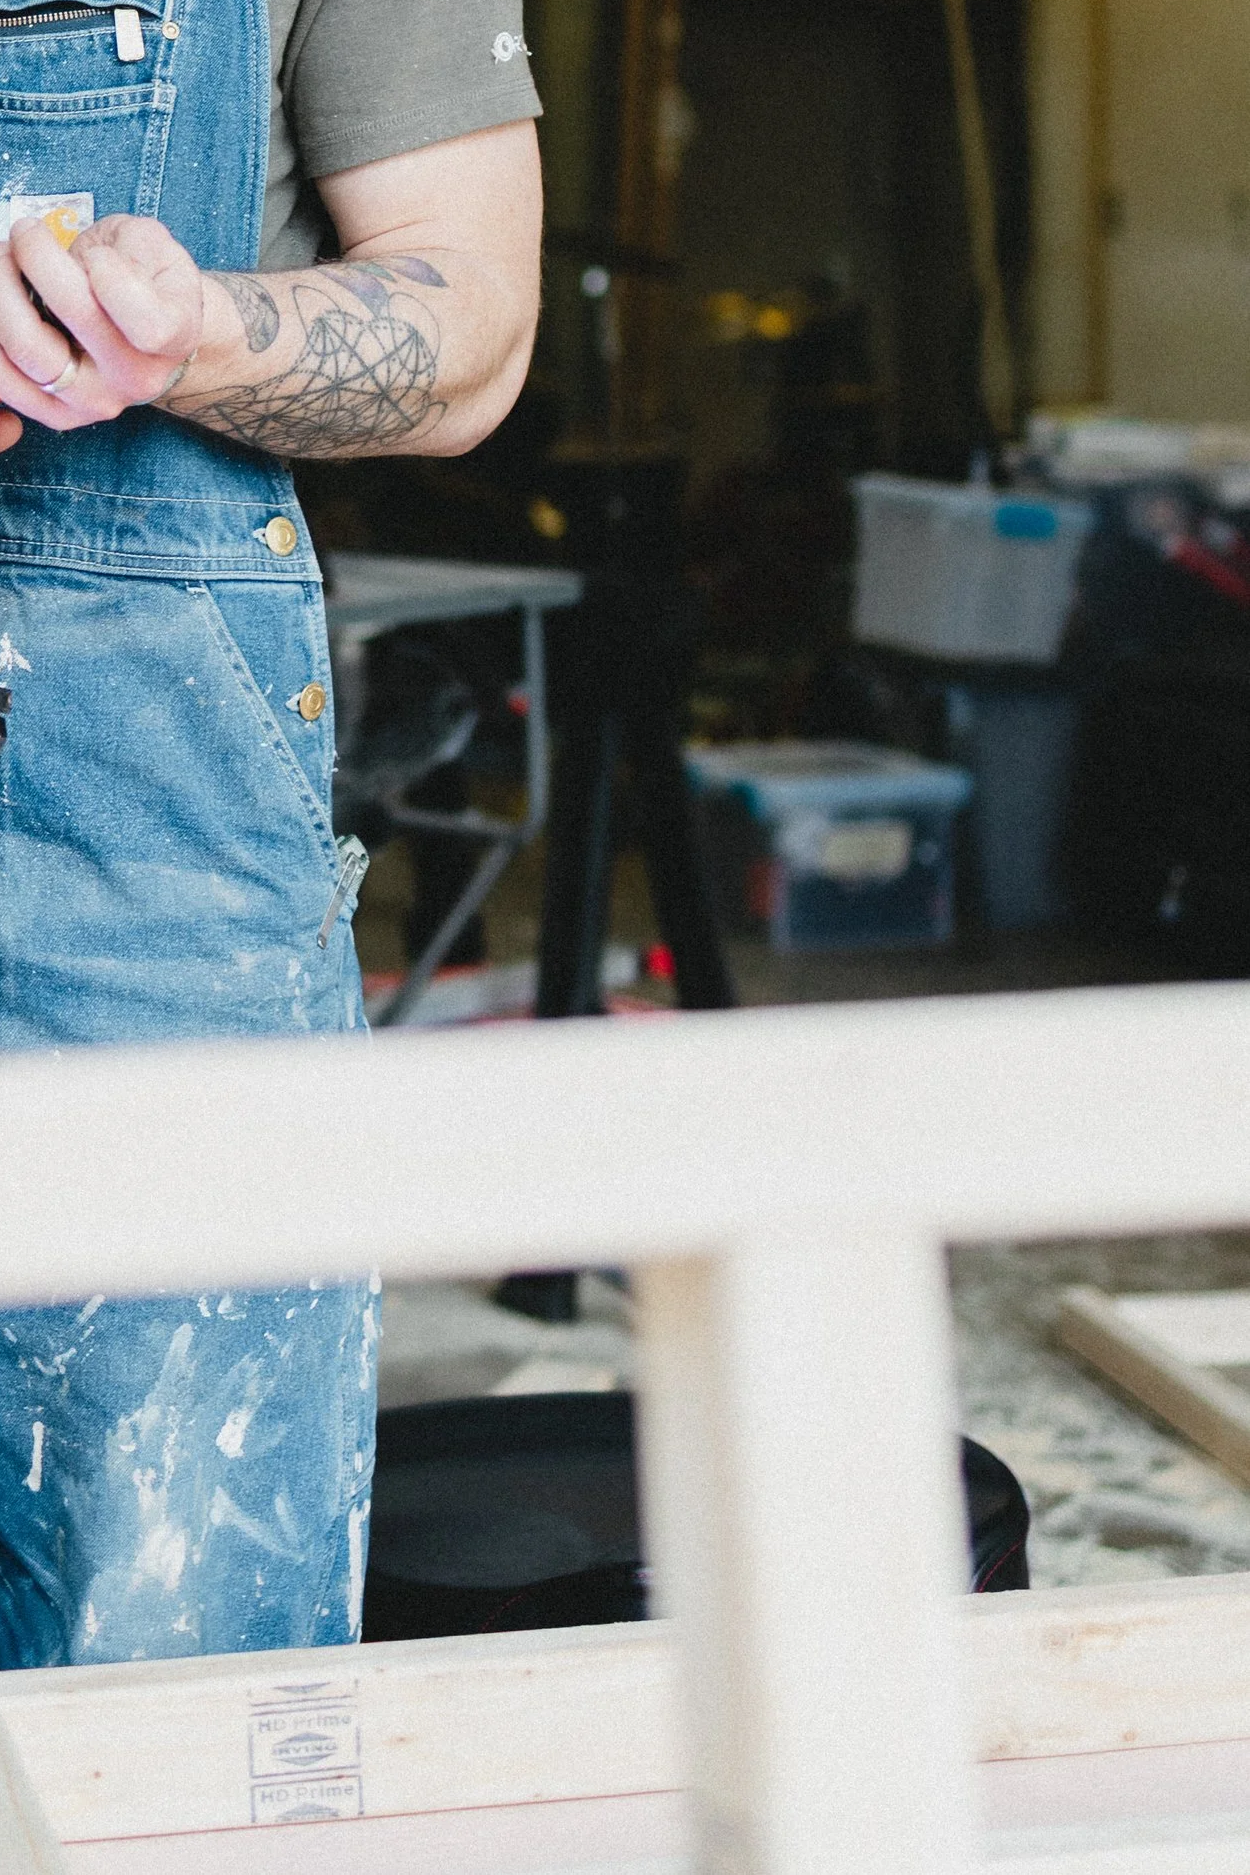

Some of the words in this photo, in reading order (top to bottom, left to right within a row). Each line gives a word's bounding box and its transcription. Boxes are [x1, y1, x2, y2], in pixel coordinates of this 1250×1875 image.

[258, 1718, 287, 1733] HD
[271, 1742, 339, 1755] IRVING
[260, 1788, 289, 1803] HD
[296, 1784, 355, 1801] Prime
